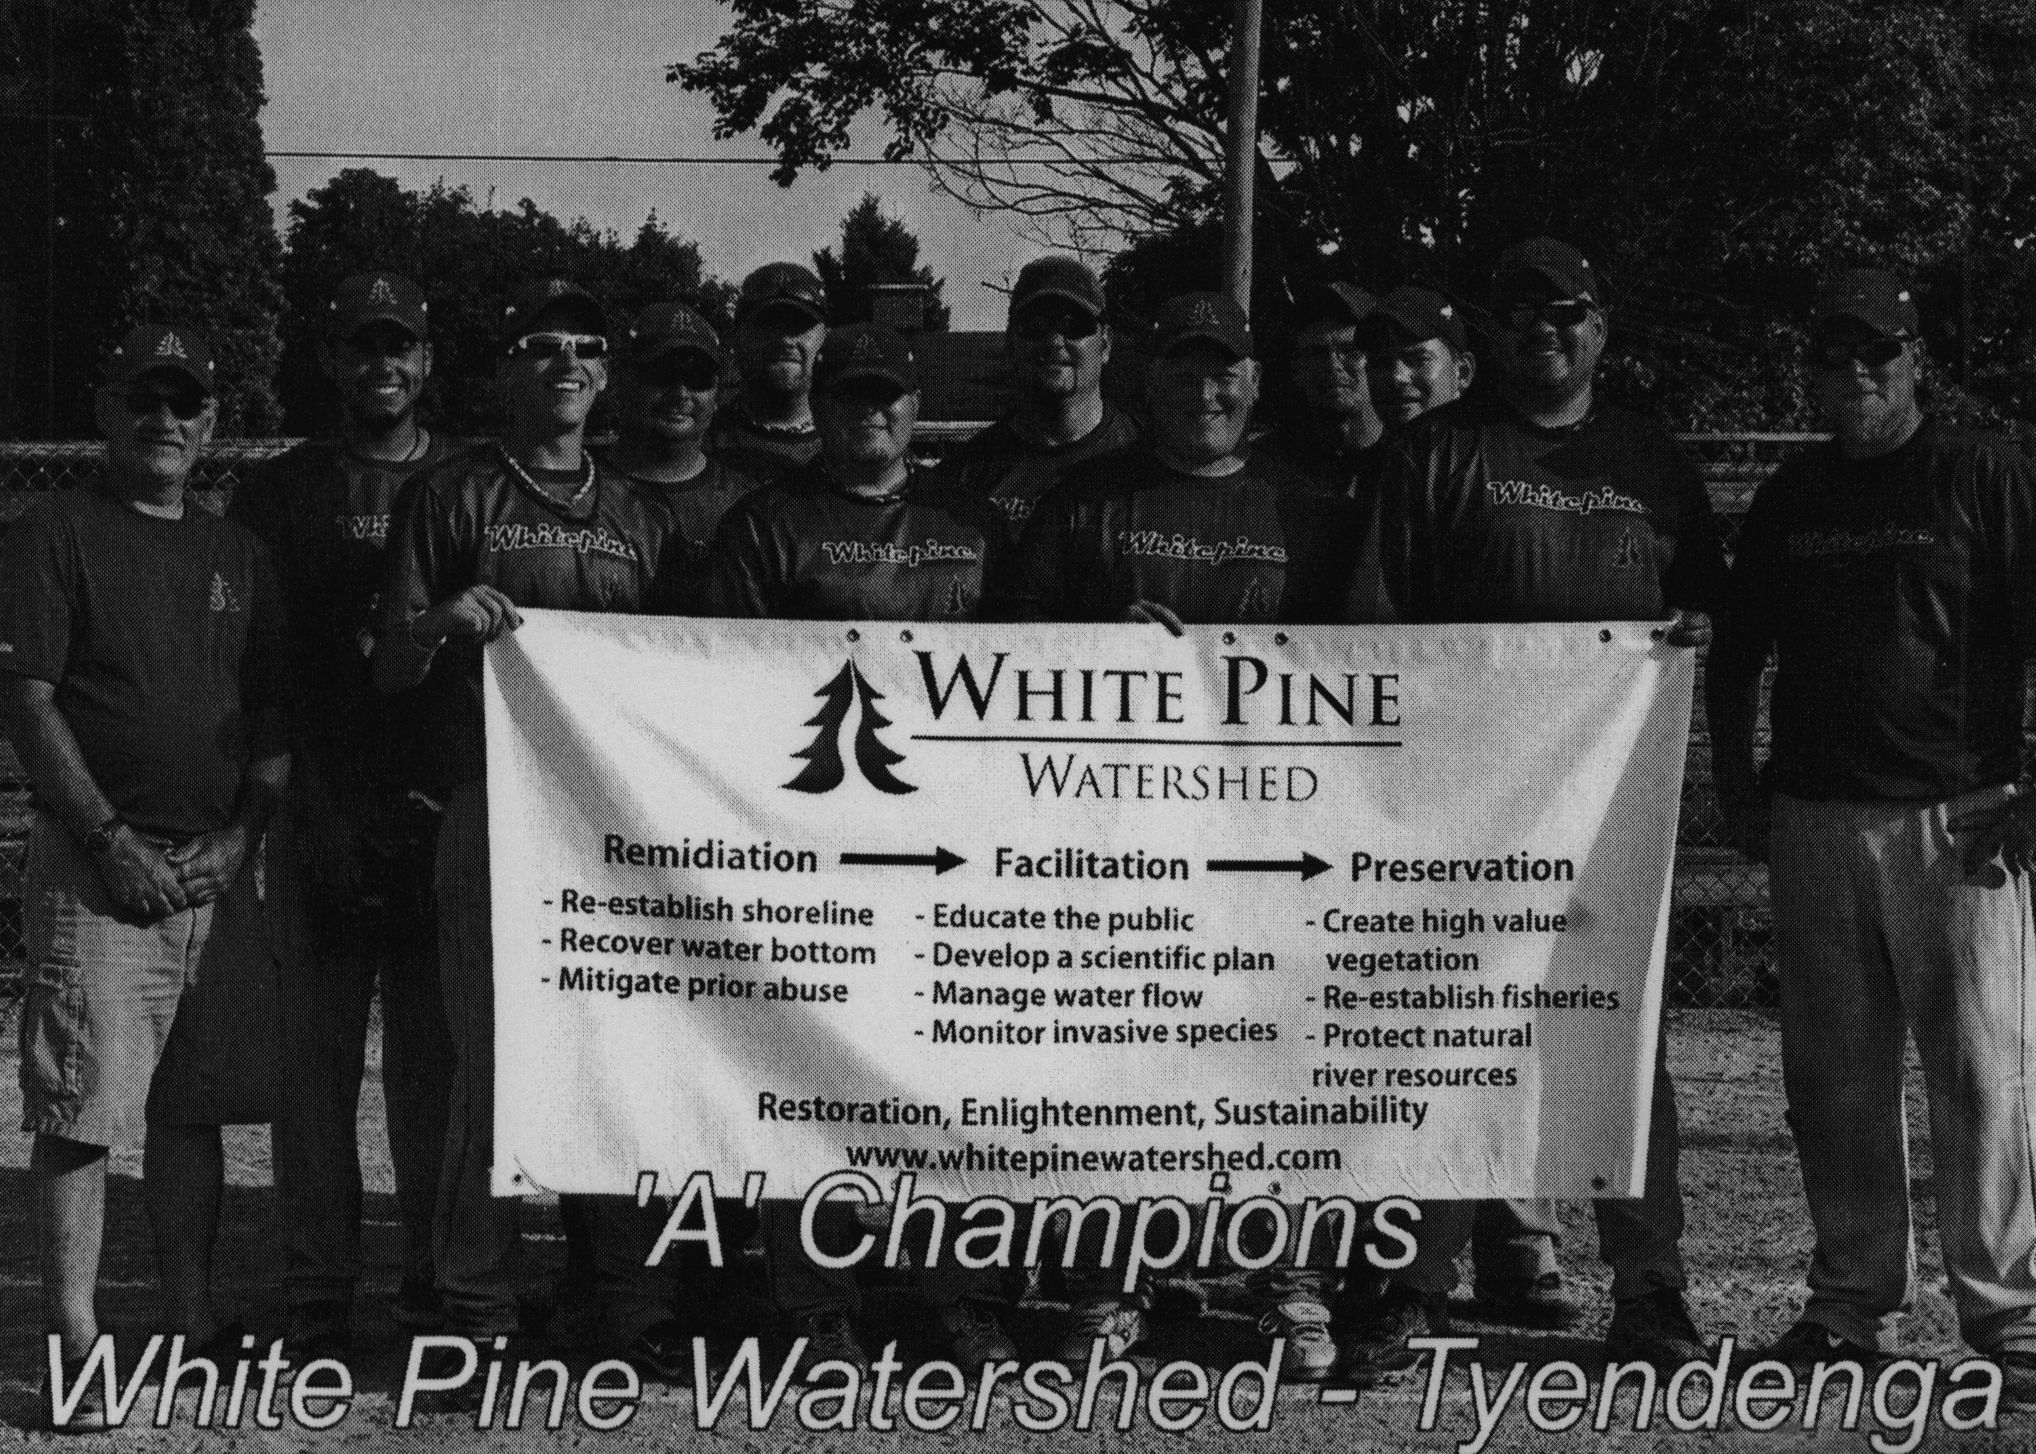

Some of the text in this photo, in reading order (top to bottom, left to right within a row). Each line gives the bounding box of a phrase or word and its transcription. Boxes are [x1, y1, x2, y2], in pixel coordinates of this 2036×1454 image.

[914, 651, 1401, 727] WHITE PINE
[1020, 753, 1318, 802] WATERSHED
[604, 834, 1574, 884] Remidiation Facilitation Preservation
[561, 890, 733, 922] Re-establish
[742, 899, 874, 926] shoreline
[933, 905, 1045, 930] Educate
[1053, 906, 1100, 932] the
[1108, 906, 1194, 936] public
[1324, 908, 1414, 934] Create
[1422, 908, 1484, 938] high
[1493, 909, 1567, 934] value
[560, 928, 673, 957] Recover
[681, 936, 763, 962] water
[771, 938, 876, 966] bottom
[933, 942, 1049, 974] Develop
[1056, 950, 1072, 969] a
[1080, 946, 1206, 971] scientific
[1214, 948, 1274, 976] plan
[1326, 948, 1480, 976] vegetation
[559, 967, 680, 1000] Mitigate
[688, 973, 756, 1001] prior
[763, 977, 849, 1003] abuse
[932, 982, 1046, 1013] Manage
[1054, 985, 1134, 1010] water
[1142, 984, 1203, 1009] flow
[1324, 984, 1494, 1010] Re-establish
[1502, 984, 1620, 1010] fisheries
[932, 1019, 1046, 1045] Monitor
[1054, 1019, 1170, 1044] invasive
[1176, 1018, 1278, 1048] species
[1324, 1024, 1426, 1049] Protect
[1434, 1022, 1532, 1048] natural
[1313, 1064, 1518, 1087] river resources
[758, 1092, 1428, 1134] Restoration, Enlightenment, Sustainability
[846, 1142, 1342, 1178] www.whitepinewatershed.com
